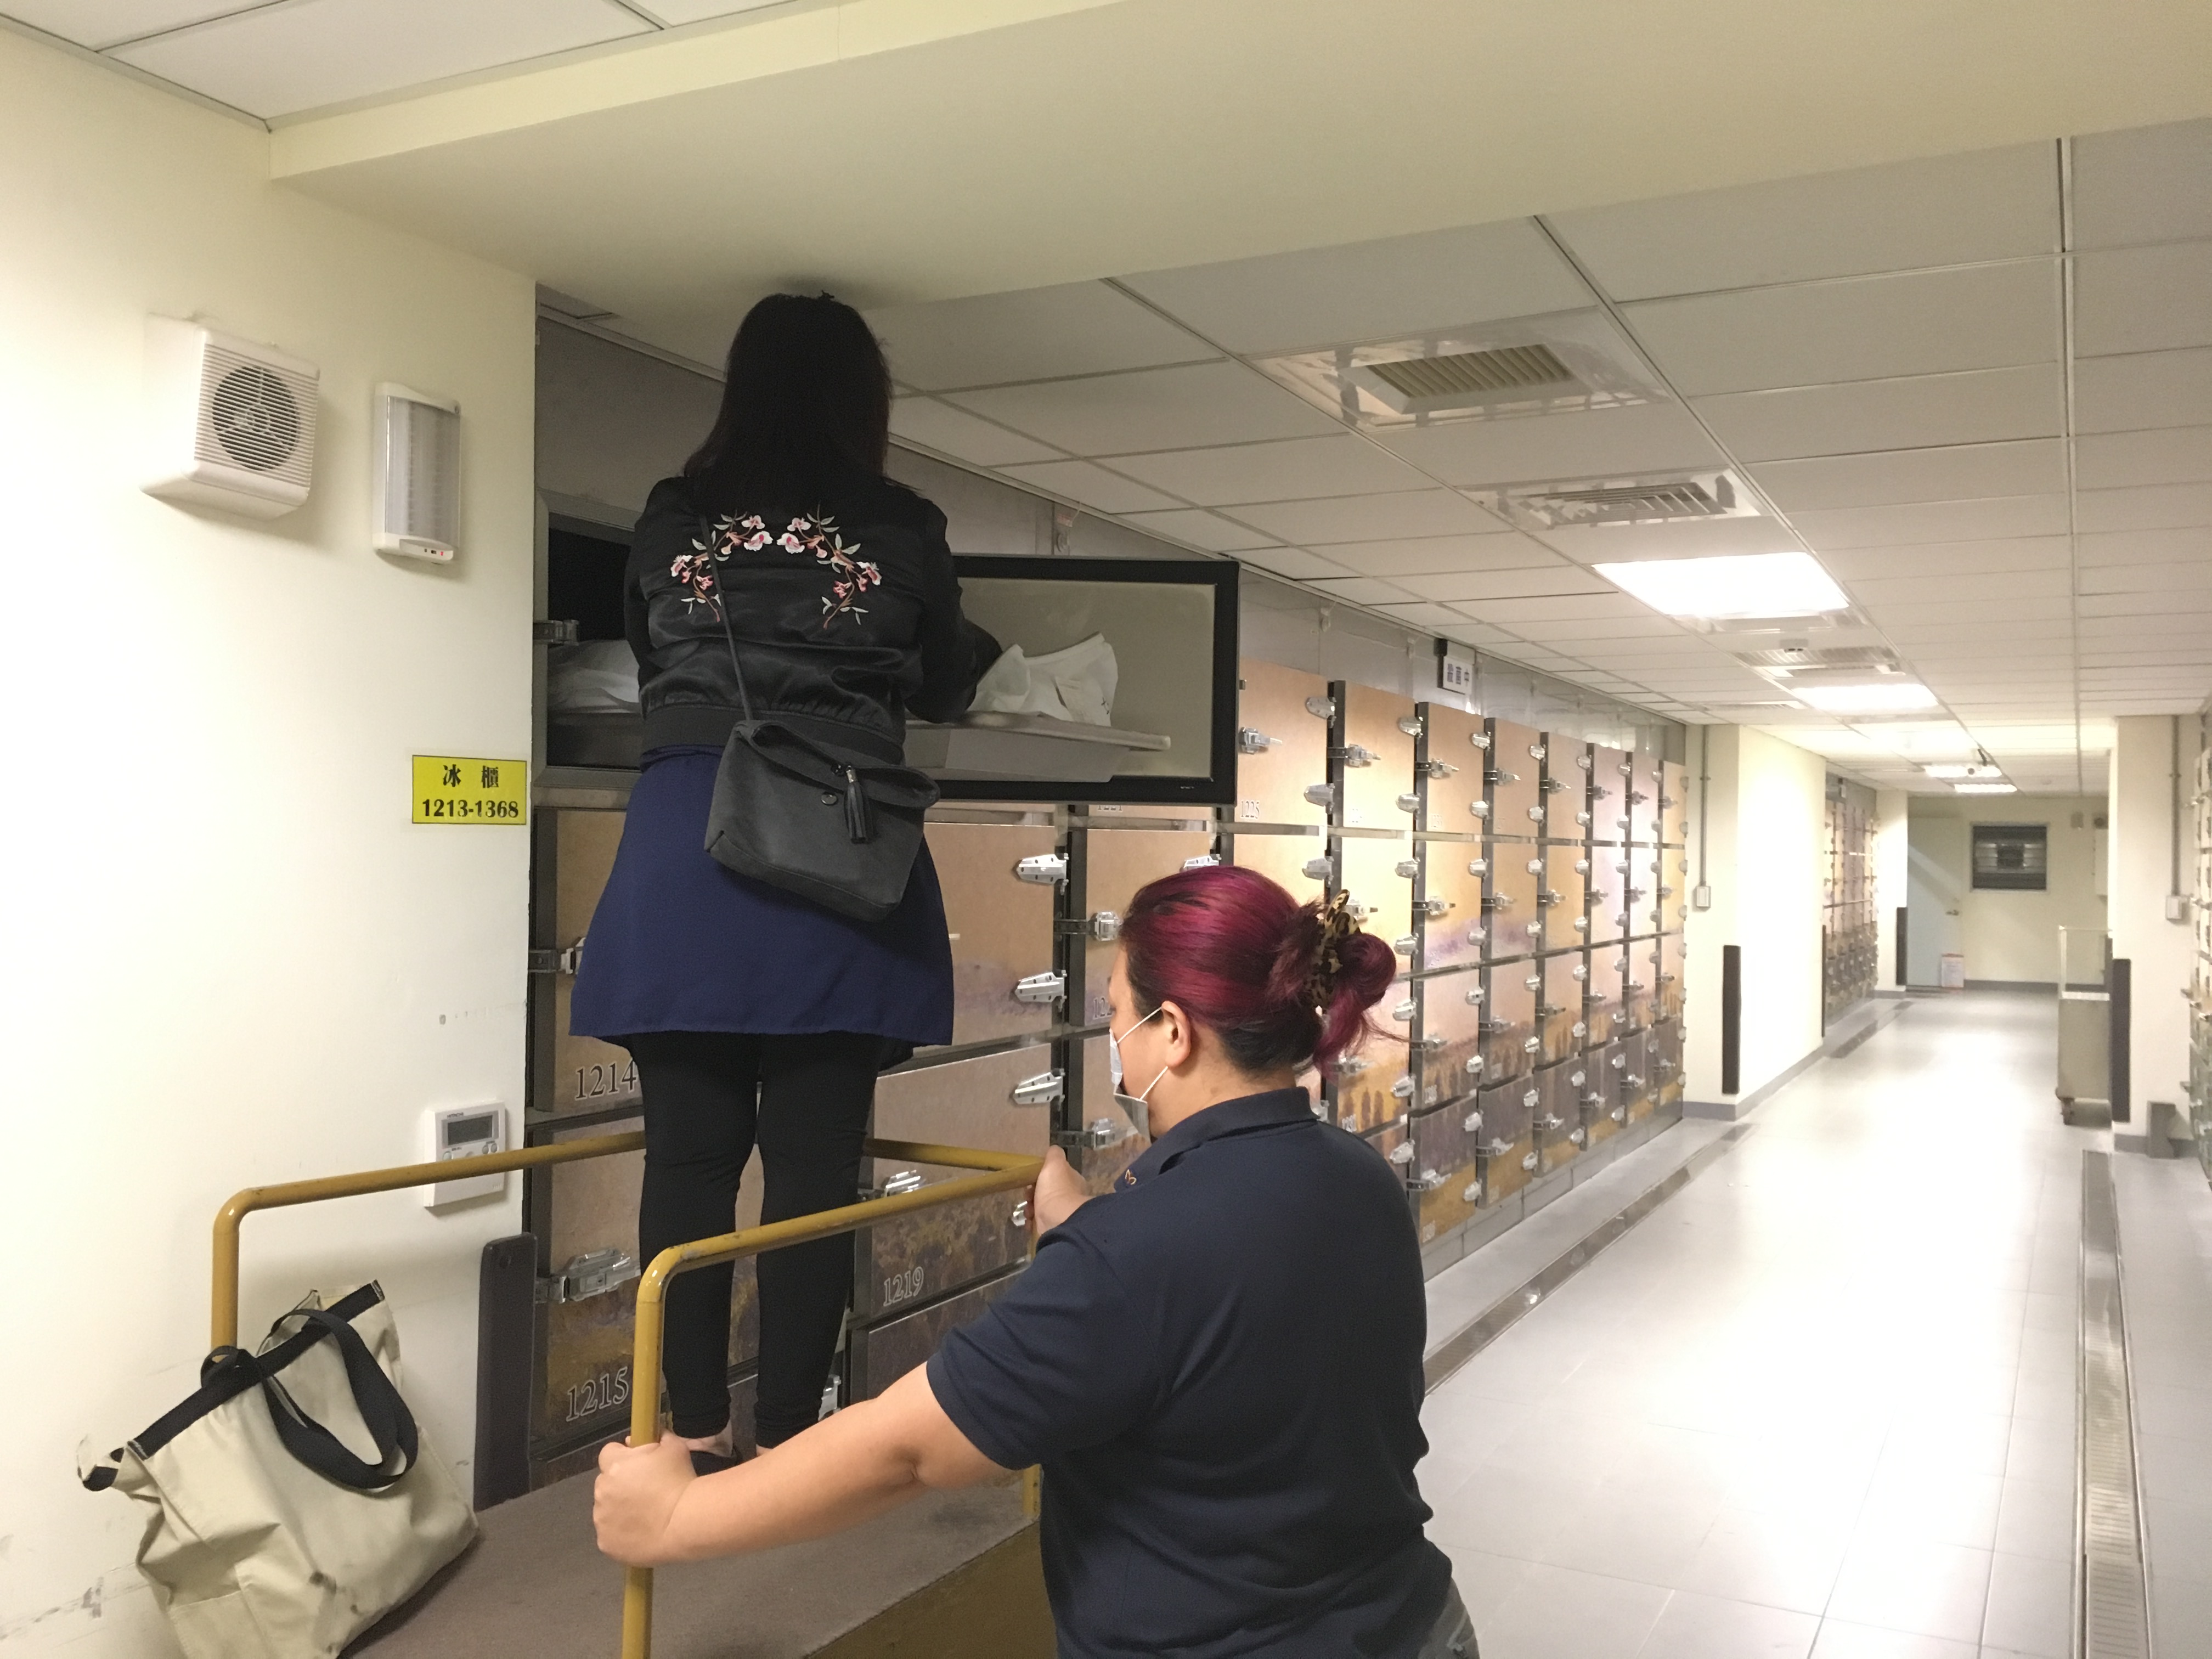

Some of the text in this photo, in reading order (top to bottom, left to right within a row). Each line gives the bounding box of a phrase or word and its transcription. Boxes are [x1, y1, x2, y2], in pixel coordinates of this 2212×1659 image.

[442, 764, 499, 789] 冰櫃
[422, 799, 519, 819] 1213-1368
[1240, 800, 1260, 820] 1225
[1093, 996, 1113, 1020] 122
[575, 1059, 637, 1100] 1214
[883, 1266, 924, 1307] 1219
[566, 1366, 629, 1422] 1215
